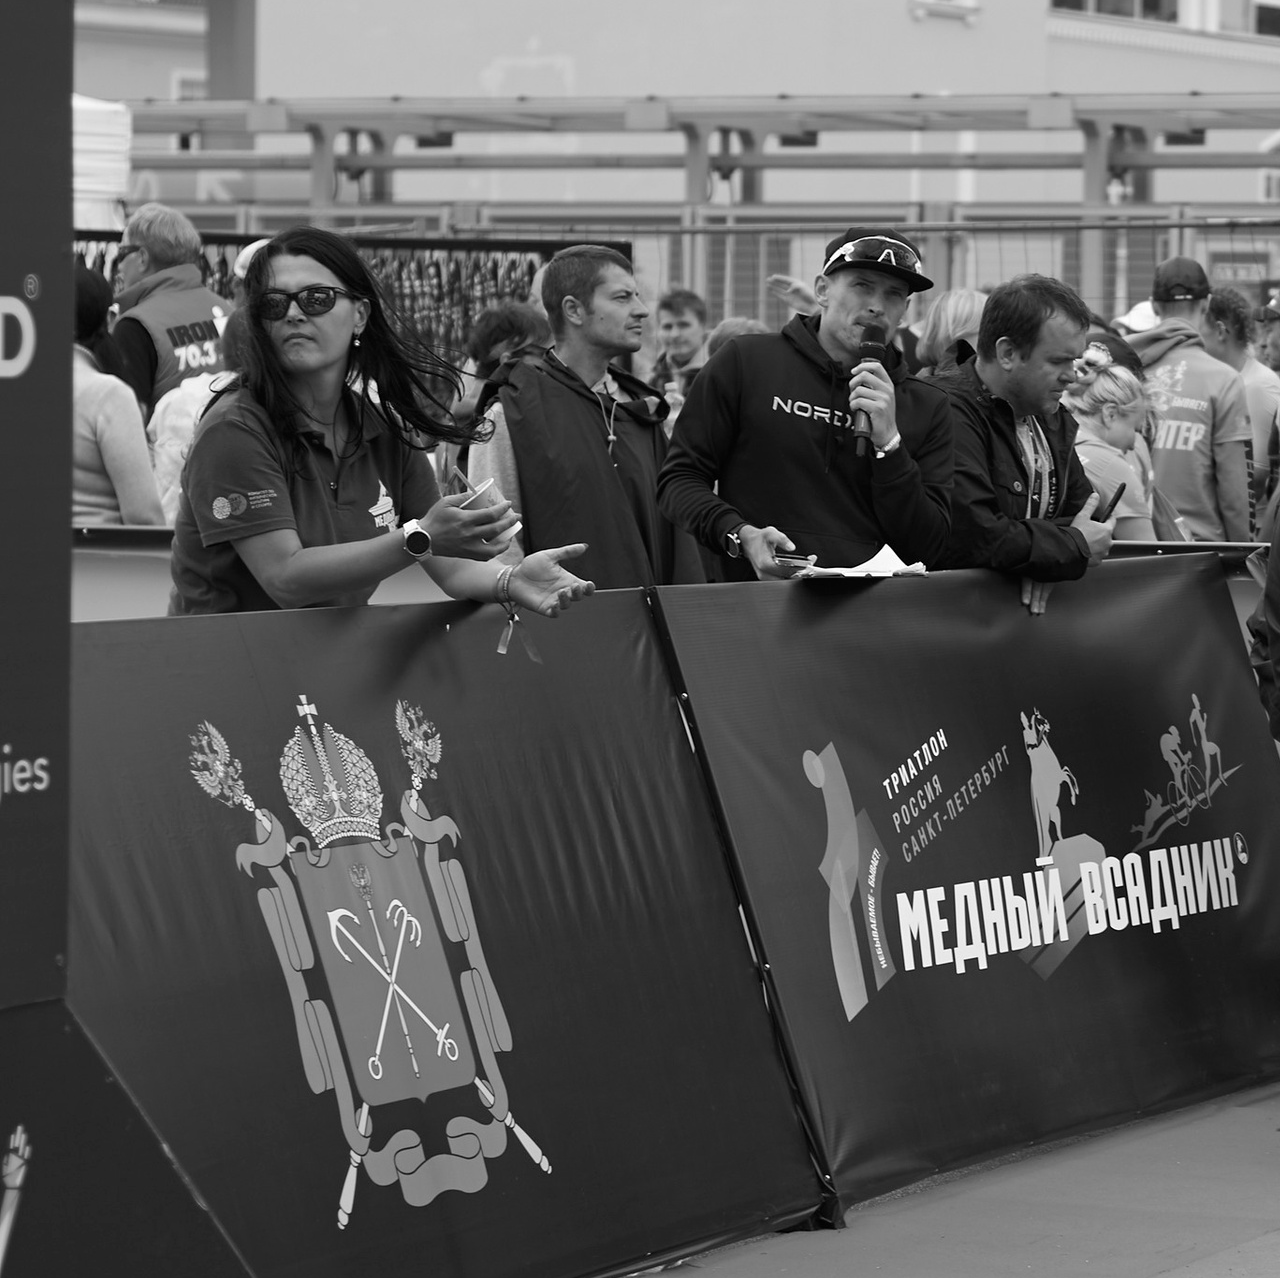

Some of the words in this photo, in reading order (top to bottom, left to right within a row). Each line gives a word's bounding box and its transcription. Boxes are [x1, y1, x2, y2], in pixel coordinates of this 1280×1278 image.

[173, 341, 217, 372] 70.3
[771, 395, 855, 430] NORD
[0, 744, 51, 801] ies
[882, 728, 949, 800] ТРИАТЛОН
[891, 774, 943, 833] РОССИЯ
[901, 745, 1010, 864] САНКТ-ПЕТЕРБУРГ
[867, 847, 881, 888] БЫВАЕТ!
[867, 893, 888, 969] НЕБЫВАЕМОЕ
[895, 856, 1069, 975] МЕДНЫЙ
[1079, 839, 1239, 935] ВСАДНИК
